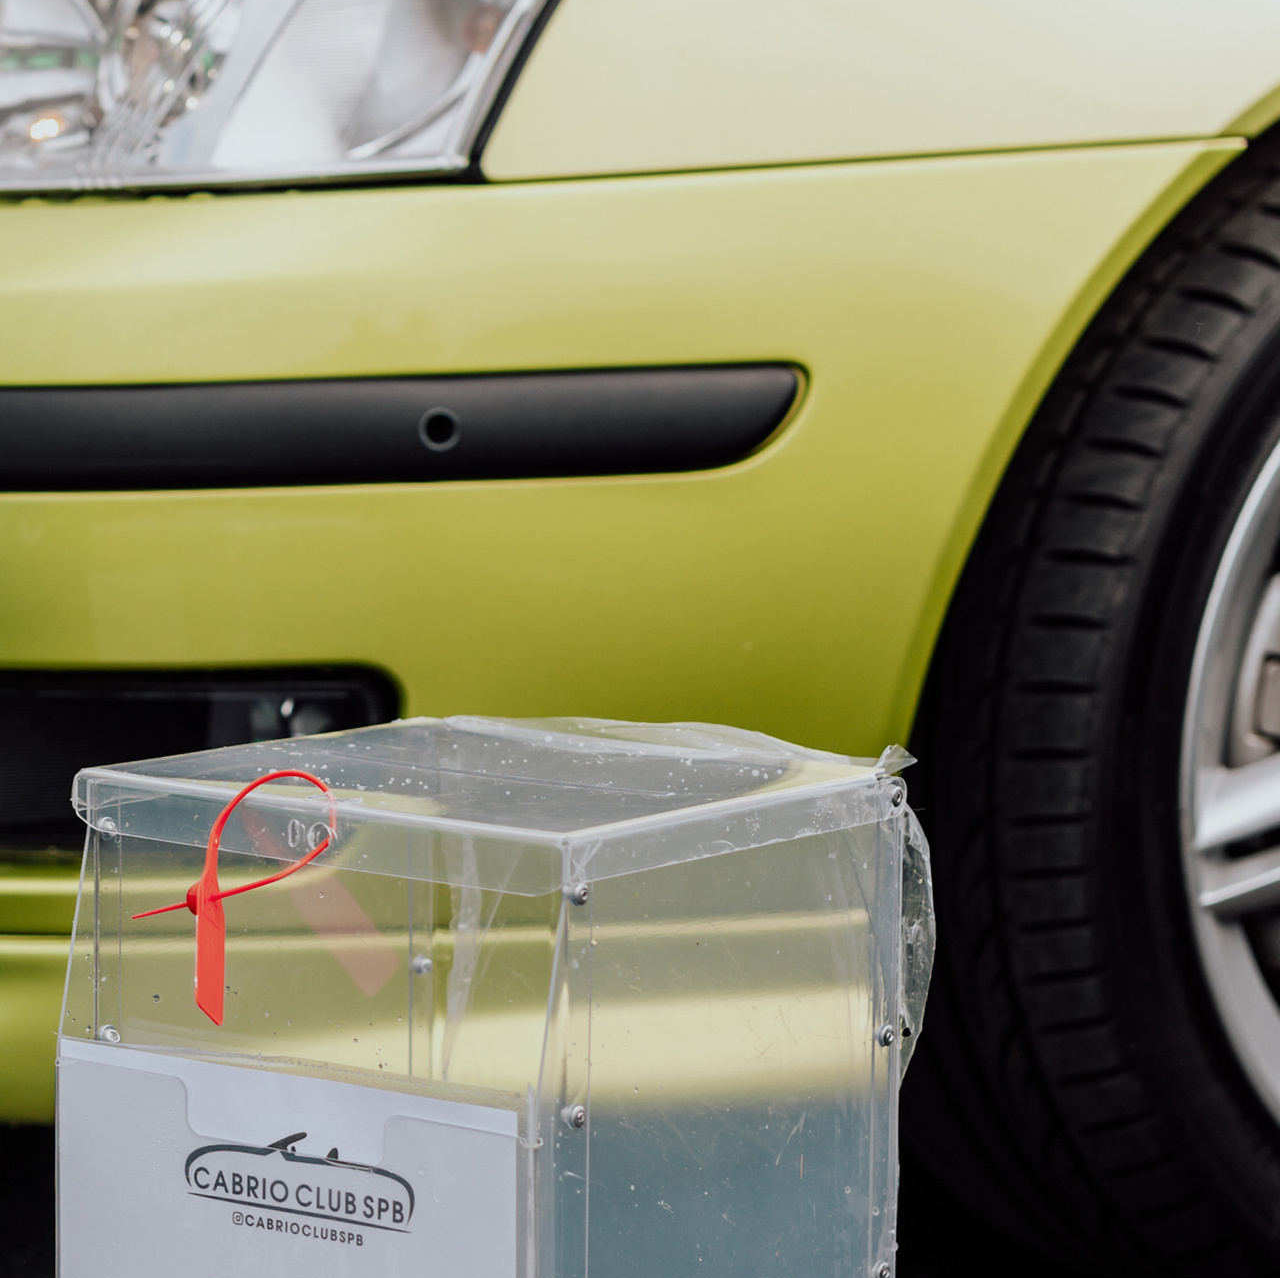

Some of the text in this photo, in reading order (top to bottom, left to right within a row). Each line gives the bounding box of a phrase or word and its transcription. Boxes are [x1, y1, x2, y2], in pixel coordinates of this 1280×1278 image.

[193, 1166, 405, 1224] CABRIO CLUB SPB
